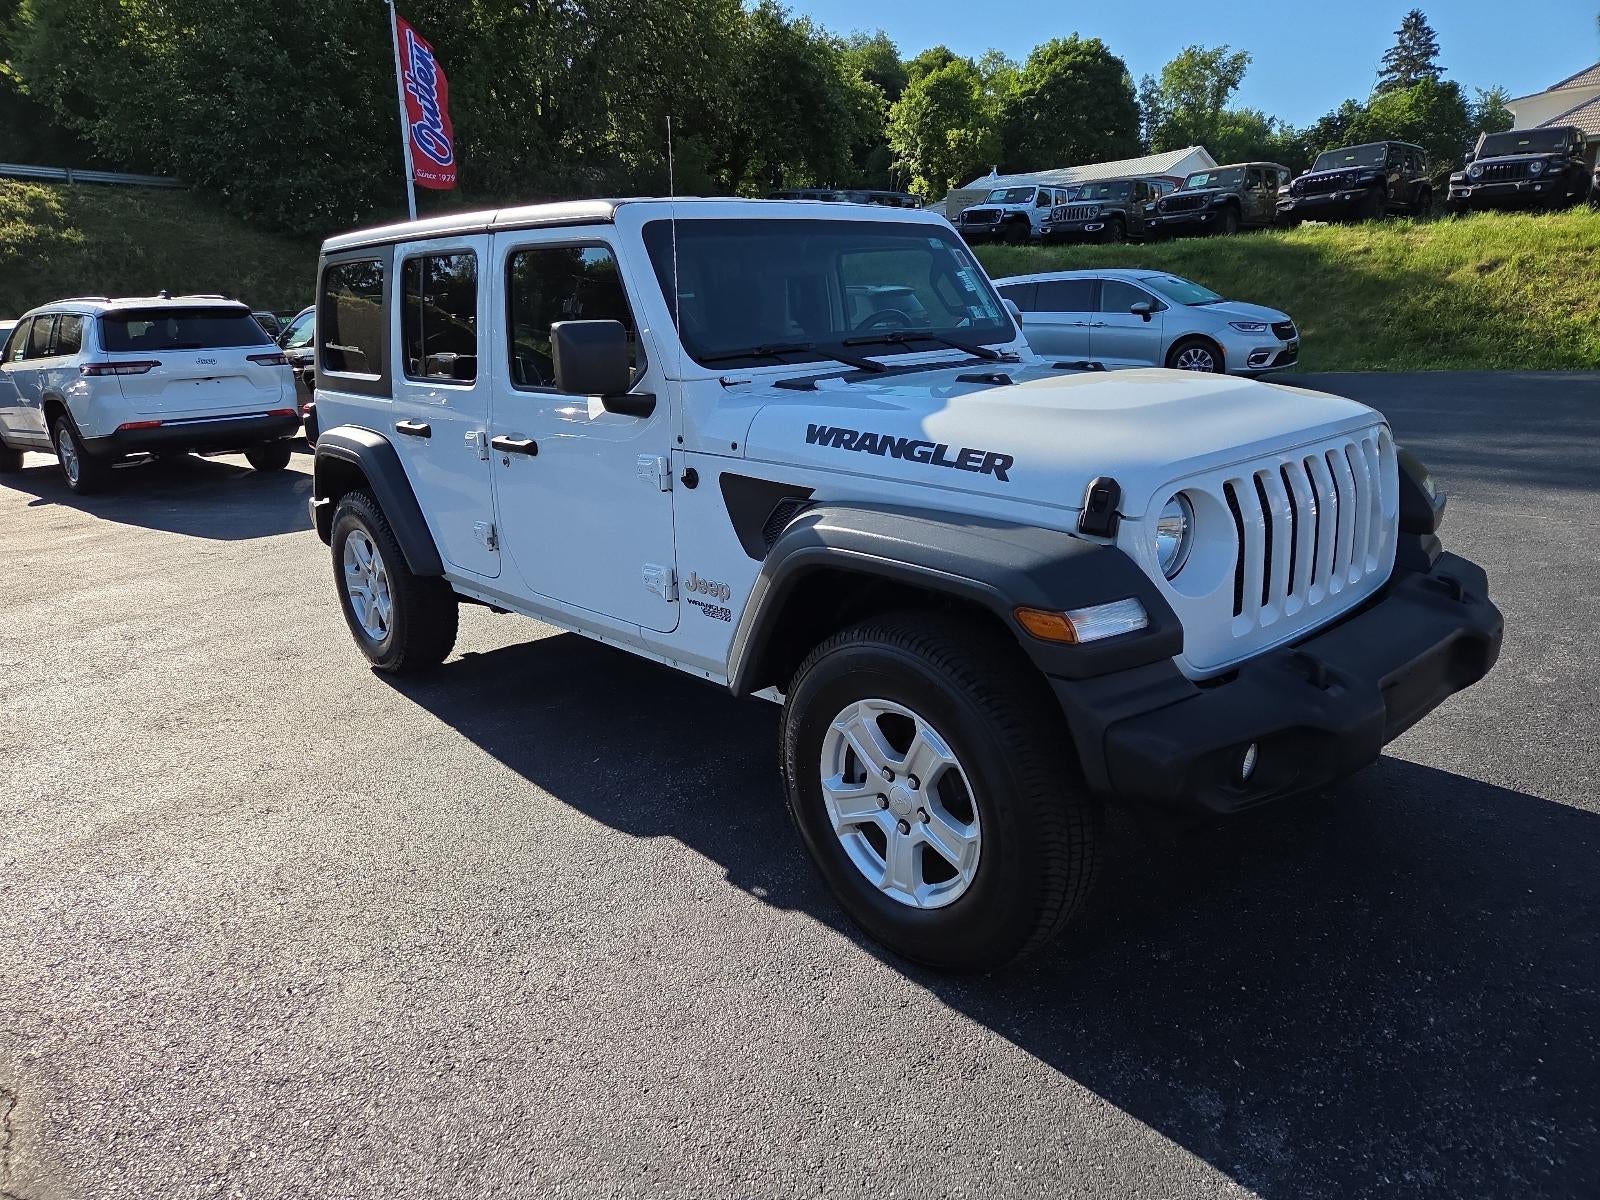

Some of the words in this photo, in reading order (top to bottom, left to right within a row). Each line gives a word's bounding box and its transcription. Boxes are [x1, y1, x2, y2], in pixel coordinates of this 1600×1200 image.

[405, 29, 454, 167] Outten
[416, 168, 437, 180] Since
[195, 357, 218, 366] Jeep
[805, 423, 1014, 482] WRANGLER
[685, 570, 731, 603] Jeep
[686, 598, 731, 615] WRANGLER
